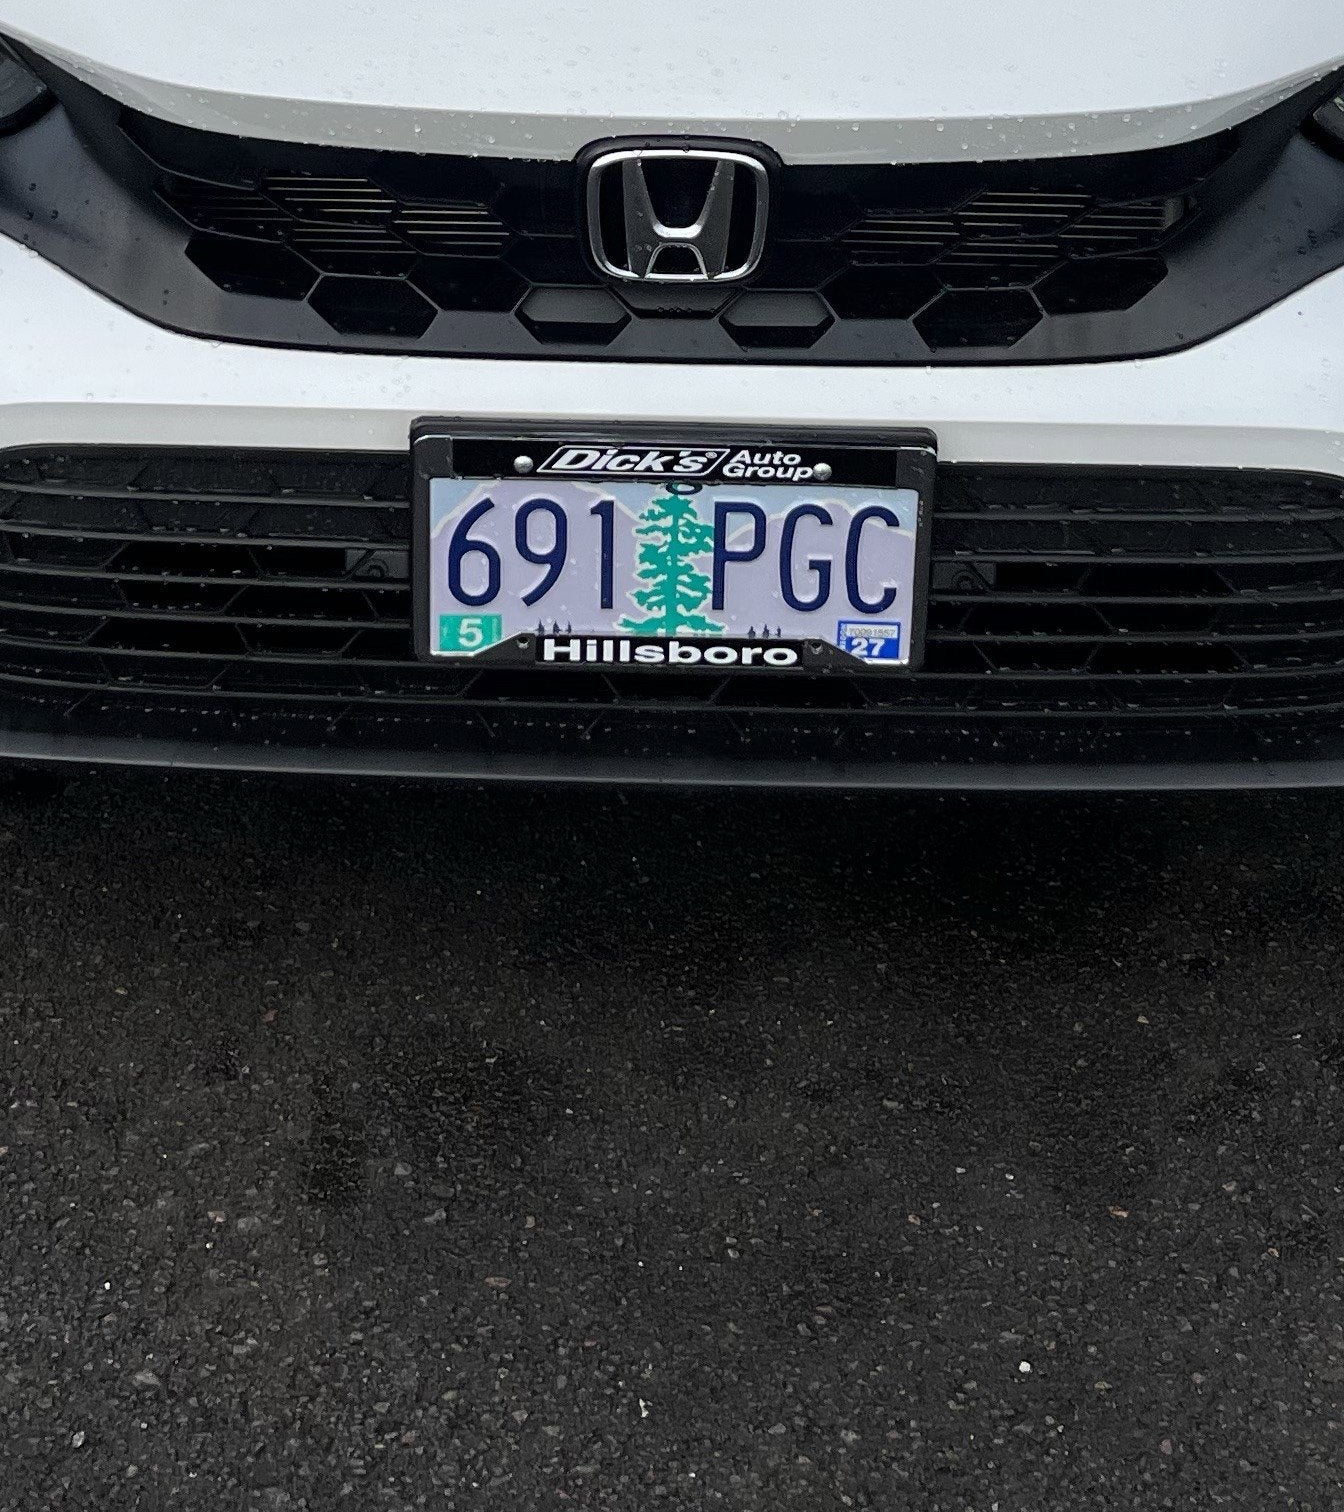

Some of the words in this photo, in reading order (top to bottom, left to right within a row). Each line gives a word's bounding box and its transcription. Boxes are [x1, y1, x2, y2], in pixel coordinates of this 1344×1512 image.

[551, 448, 708, 473] Dick's
[728, 449, 802, 466] Auto
[721, 462, 814, 482] Group
[448, 497, 615, 609] 691
[712, 501, 900, 614] PGC
[458, 618, 483, 648] 5
[543, 638, 799, 666] Hillsboro
[850, 637, 886, 657] 27
